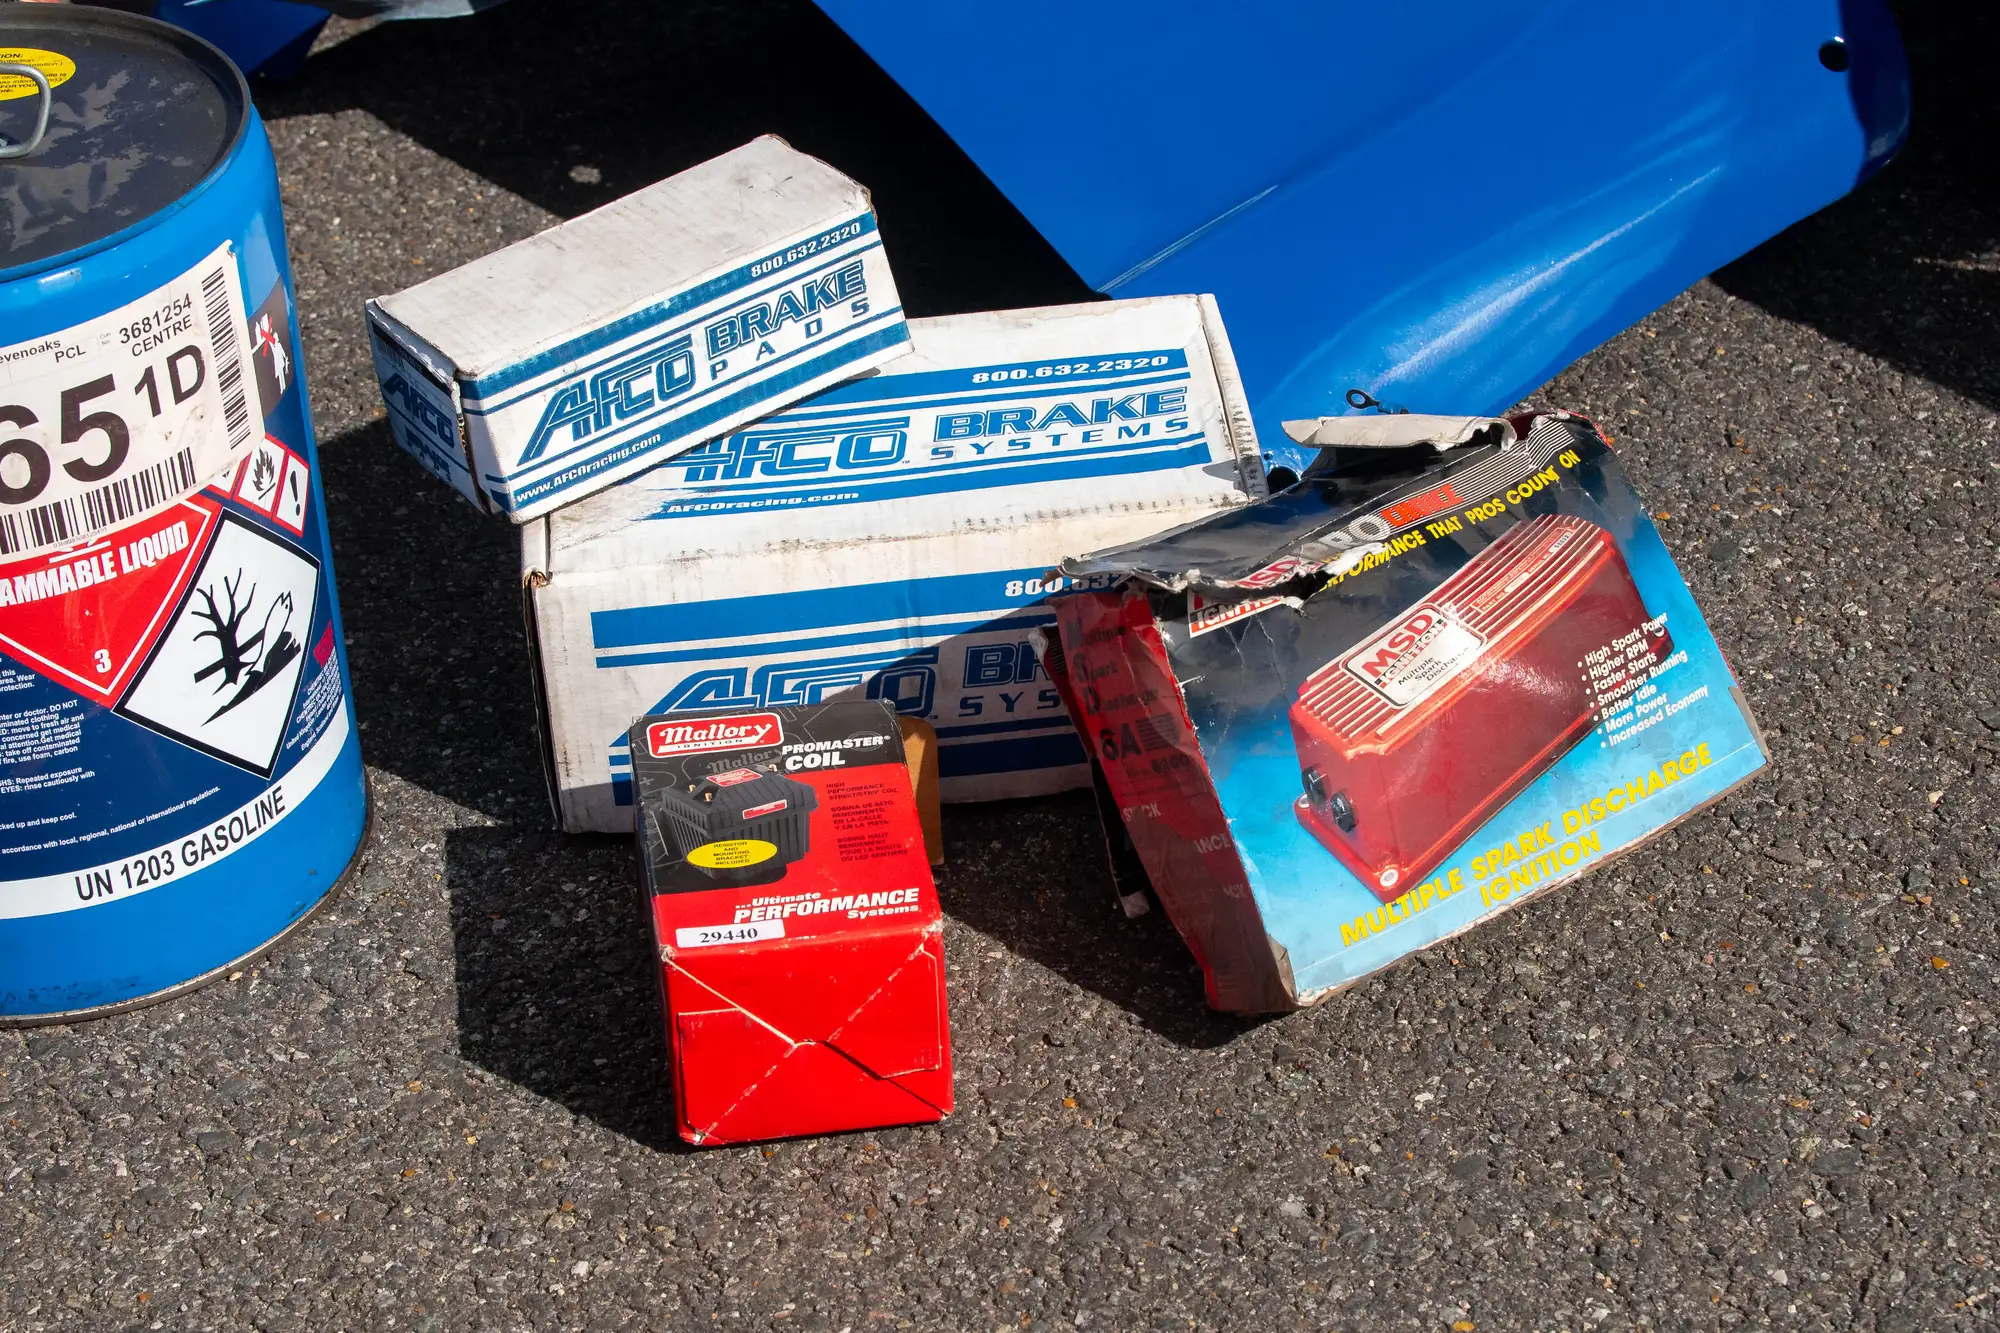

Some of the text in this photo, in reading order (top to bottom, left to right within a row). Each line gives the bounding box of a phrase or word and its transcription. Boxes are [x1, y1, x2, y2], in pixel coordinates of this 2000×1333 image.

[751, 222, 861, 278] 800.632.2320
[118, 293, 193, 344] 3681254
[132, 314, 193, 358] CENTRE
[55, 345, 87, 363] PCL
[517, 333, 697, 466] AFCO
[705, 259, 868, 360] BRAKE
[972, 356, 1169, 384] 800.632.2320
[134, 344, 206, 418] 1D
[933, 386, 1188, 443] BRAKE
[517, 434, 662, 503] www.AFCOracing.com
[1426, 515, 1464, 540] THAT
[1465, 498, 1507, 525] PROS
[1506, 465, 1560, 506] COUNT
[1558, 449, 1582, 469] ON
[0, 520, 190, 607] AMMABLE LIQUID
[1362, 612, 1435, 679] MSD
[1377, 619, 1445, 687] IGNITION
[1585, 612, 1668, 667] High Spark Power
[1588, 639, 1649, 680] Higher RPM
[93, 648, 112, 674] 3
[1398, 656, 1435, 686] Multiple
[1414, 659, 1442, 682] Spark
[1593, 651, 1657, 693] Faster Starts
[1597, 650, 1688, 706] Smoother Running
[23, 707, 48, 717] doctor.
[49, 703, 62, 712] DO
[62, 699, 78, 710] NOT
[30, 712, 60, 724] clothing
[1601, 684, 1657, 720] Better Idle
[1604, 693, 1668, 733] More Power
[1609, 685, 1709, 746] Increased Economy
[11, 725, 30, 734] move
[40, 719, 60, 729] fresh
[71, 712, 84, 722] and
[53, 721, 80, 734] medical
[54, 728, 82, 741] medical
[660, 723, 772, 745] Mallory
[1100, 722, 1143, 762] 6A
[53, 745, 78, 756] carbon
[785, 751, 846, 771] COIL
[0, 769, 96, 794] EYES: rinse cautiously with
[15, 766, 82, 784] Repeated exposure
[27, 818, 40, 827] and
[41, 815, 58, 825] keep
[59, 811, 77, 821] cool.
[43, 840, 58, 849] with
[59, 836, 78, 846] local,
[79, 828, 110, 842] regional,
[110, 819, 136, 834] national
[146, 801, 186, 822] international
[186, 785, 220, 806] regulations.
[75, 785, 287, 901] UN 1203 GASOLINE
[1339, 742, 1713, 948] MULTIPLE SPARK DISCHARGE
[1478, 830, 1604, 909] IGNITION
[733, 888, 920, 924] PERFORMANCE
[847, 904, 920, 920] Systems
[699, 927, 758, 944] 29440
